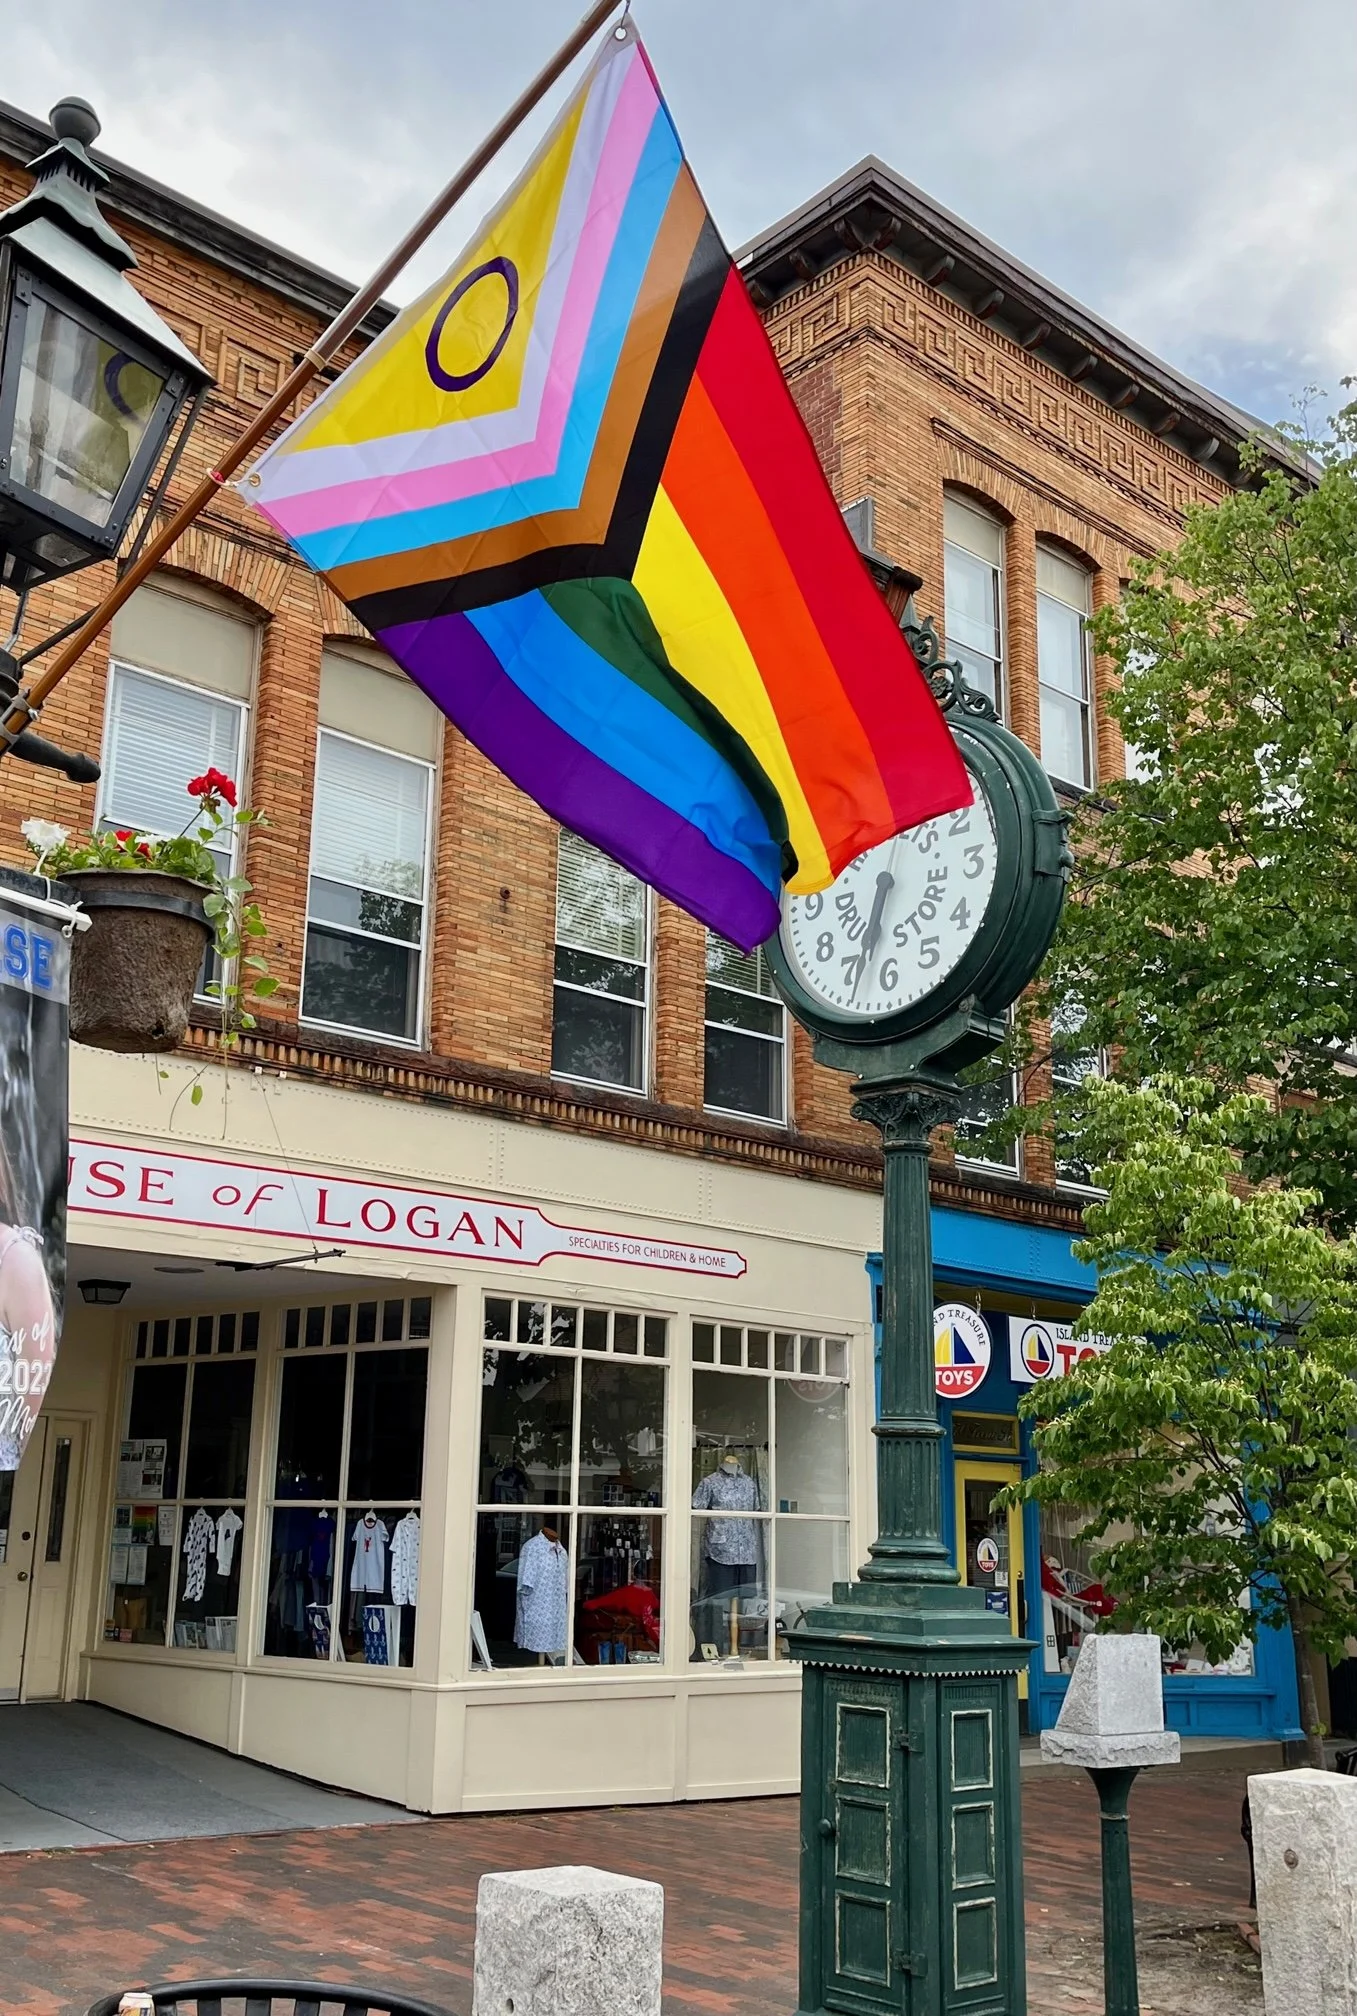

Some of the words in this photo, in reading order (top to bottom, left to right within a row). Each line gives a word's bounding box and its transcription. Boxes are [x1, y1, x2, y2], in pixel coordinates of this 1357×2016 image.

[948, 807, 970, 837] 2
[963, 844, 984, 879] 3
[805, 892, 823, 920] 9
[835, 891, 866, 941] DRU
[893, 866, 948, 948] STORE
[950, 896, 970, 931] 4
[3, 924, 54, 990] SE
[816, 932, 834, 962] 8
[918, 936, 940, 969] 5
[841, 954, 860, 985] 7
[880, 958, 898, 991] 6
[212, 1184, 284, 1215] of
[315, 1188, 525, 1250] LOGAN
[568, 1236, 620, 1253] SPECIALTIES
[622, 1243, 641, 1256] FOR
[643, 1246, 687, 1262] CHILDREN
[689, 1254, 697, 1264] &
[698, 1255, 726, 1268] HOME
[32, 1311, 50, 1352] of
[947, 1309, 986, 1347] TREASURE
[935, 1370, 974, 1386] TOYS
